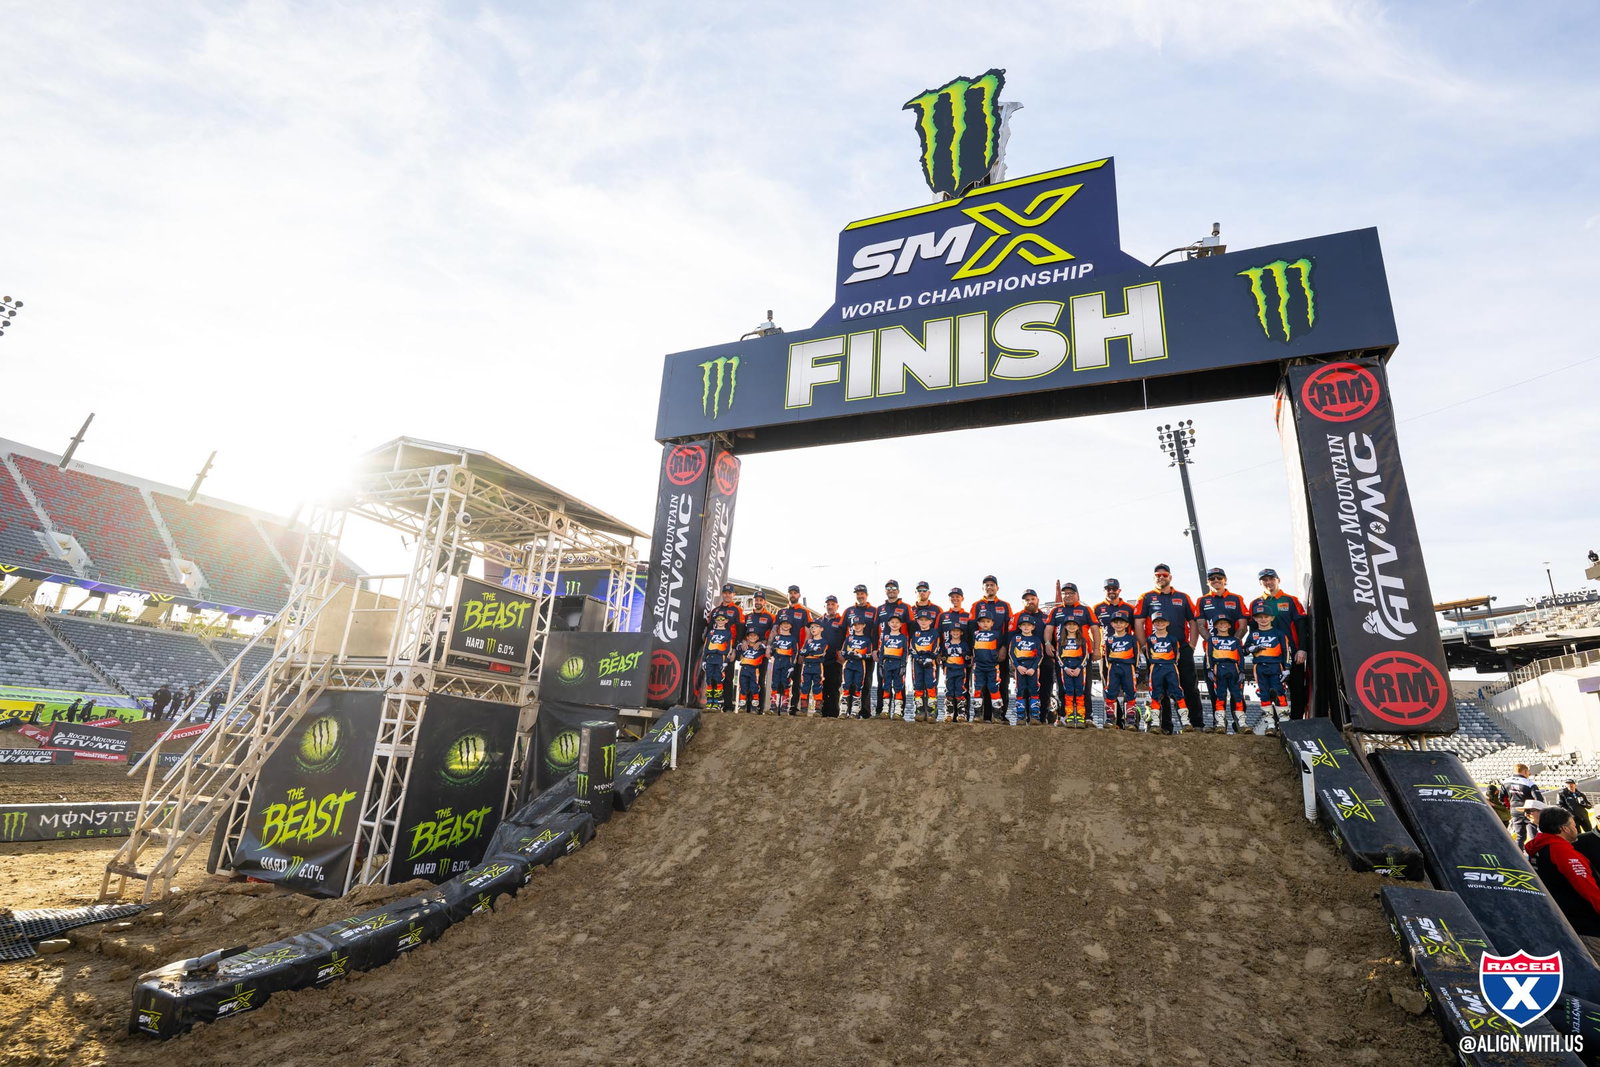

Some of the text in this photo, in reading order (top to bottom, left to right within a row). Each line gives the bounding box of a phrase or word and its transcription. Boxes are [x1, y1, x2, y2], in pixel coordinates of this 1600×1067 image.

[843, 183, 1084, 285] SMX
[841, 263, 1094, 319] WORLD CHAMPIONSHIP
[785, 283, 1169, 409] FINISH
[1316, 378, 1364, 406] RM
[673, 458, 700, 474] RM
[1327, 434, 1376, 606] ROCKY MOUNTAIN
[707, 499, 722, 574] MOUNTAIN
[654, 494, 679, 617] ROCKY MOUNTAIN
[482, 592, 496, 601] THE
[703, 576, 714, 621] ROCKY
[466, 636, 514, 655] HARD 6.0%
[1373, 673, 1428, 703] RM
[67, 732, 127, 745] ROCKY MOUNTAIN
[172, 728, 208, 740] HONDA
[12, 749, 53, 757] MOUNTAIN
[287, 787, 306, 801] THE
[1332, 788, 1369, 819] SMX
[1418, 787, 1483, 802] SMX
[435, 807, 453, 819] THE
[260, 857, 324, 881] HARD 6.0%
[413, 860, 471, 875] HARD 6.0%
[1463, 870, 1540, 892] SMX
[1493, 885, 1547, 897] CHAMPIONSHIP
[217, 993, 254, 1015] SMX
[138, 1014, 161, 1030] SMX
